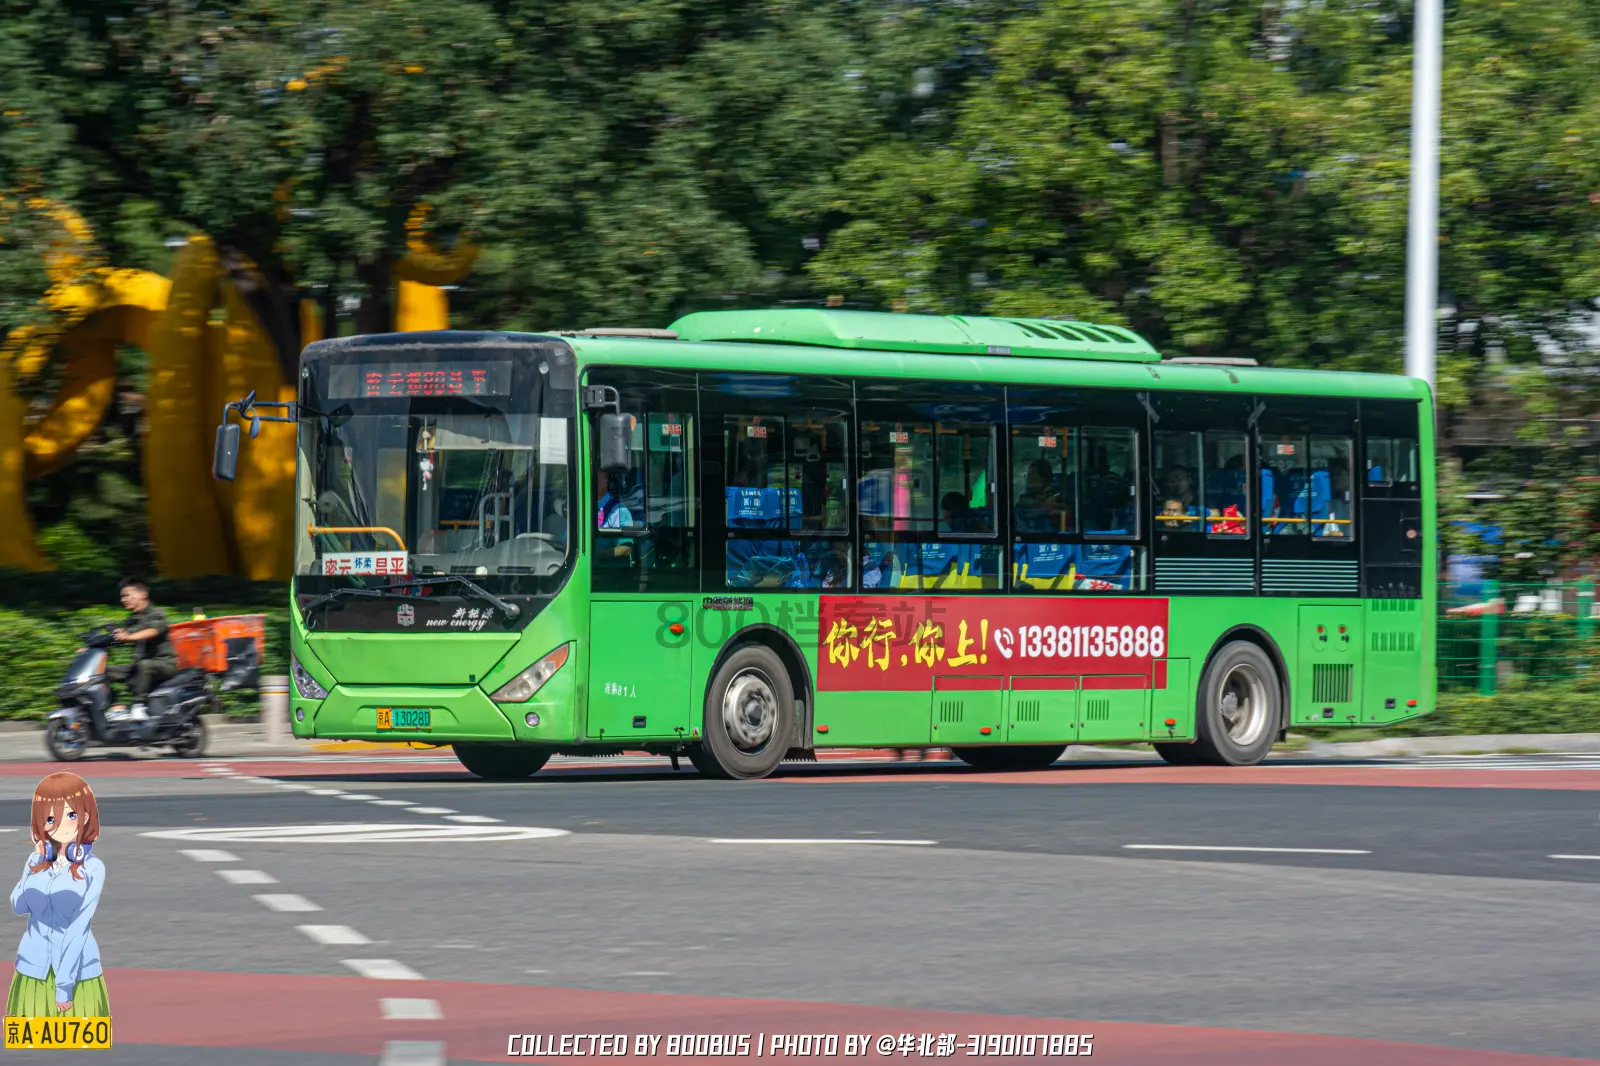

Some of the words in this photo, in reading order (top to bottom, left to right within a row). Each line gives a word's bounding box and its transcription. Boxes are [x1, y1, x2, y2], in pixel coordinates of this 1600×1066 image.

[375, 557, 404, 576] 昌平
[452, 607, 494, 619] 新能源
[450, 619, 488, 631] energy
[1018, 625, 1165, 658] 13381135888
